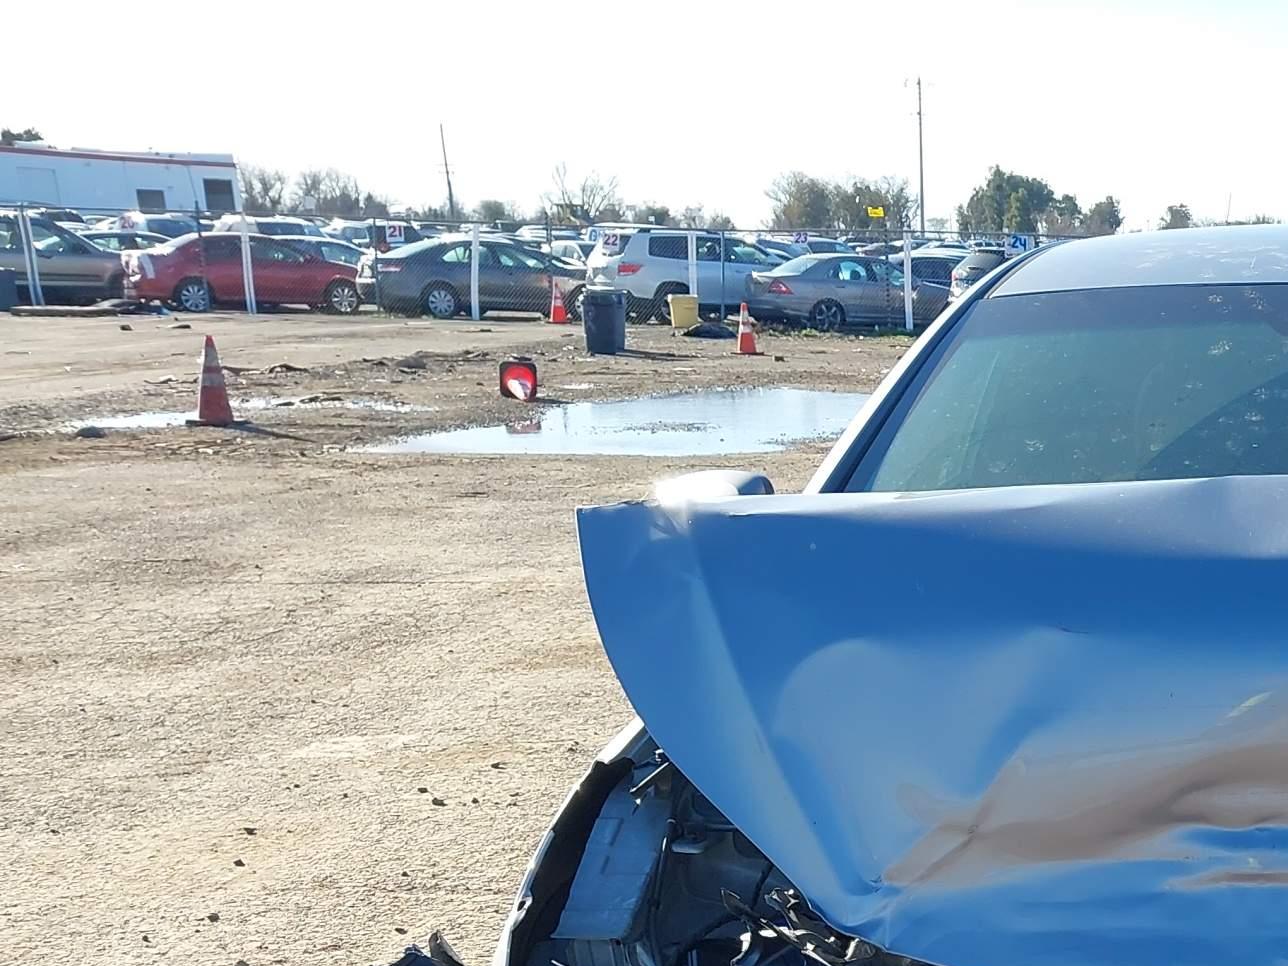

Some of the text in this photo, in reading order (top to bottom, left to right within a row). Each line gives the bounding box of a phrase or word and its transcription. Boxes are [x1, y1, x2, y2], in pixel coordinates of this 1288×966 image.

[388, 225, 403, 238] 21
[794, 232, 808, 244] 23
[603, 233, 619, 246] 22
[1011, 235, 1027, 251] 24
